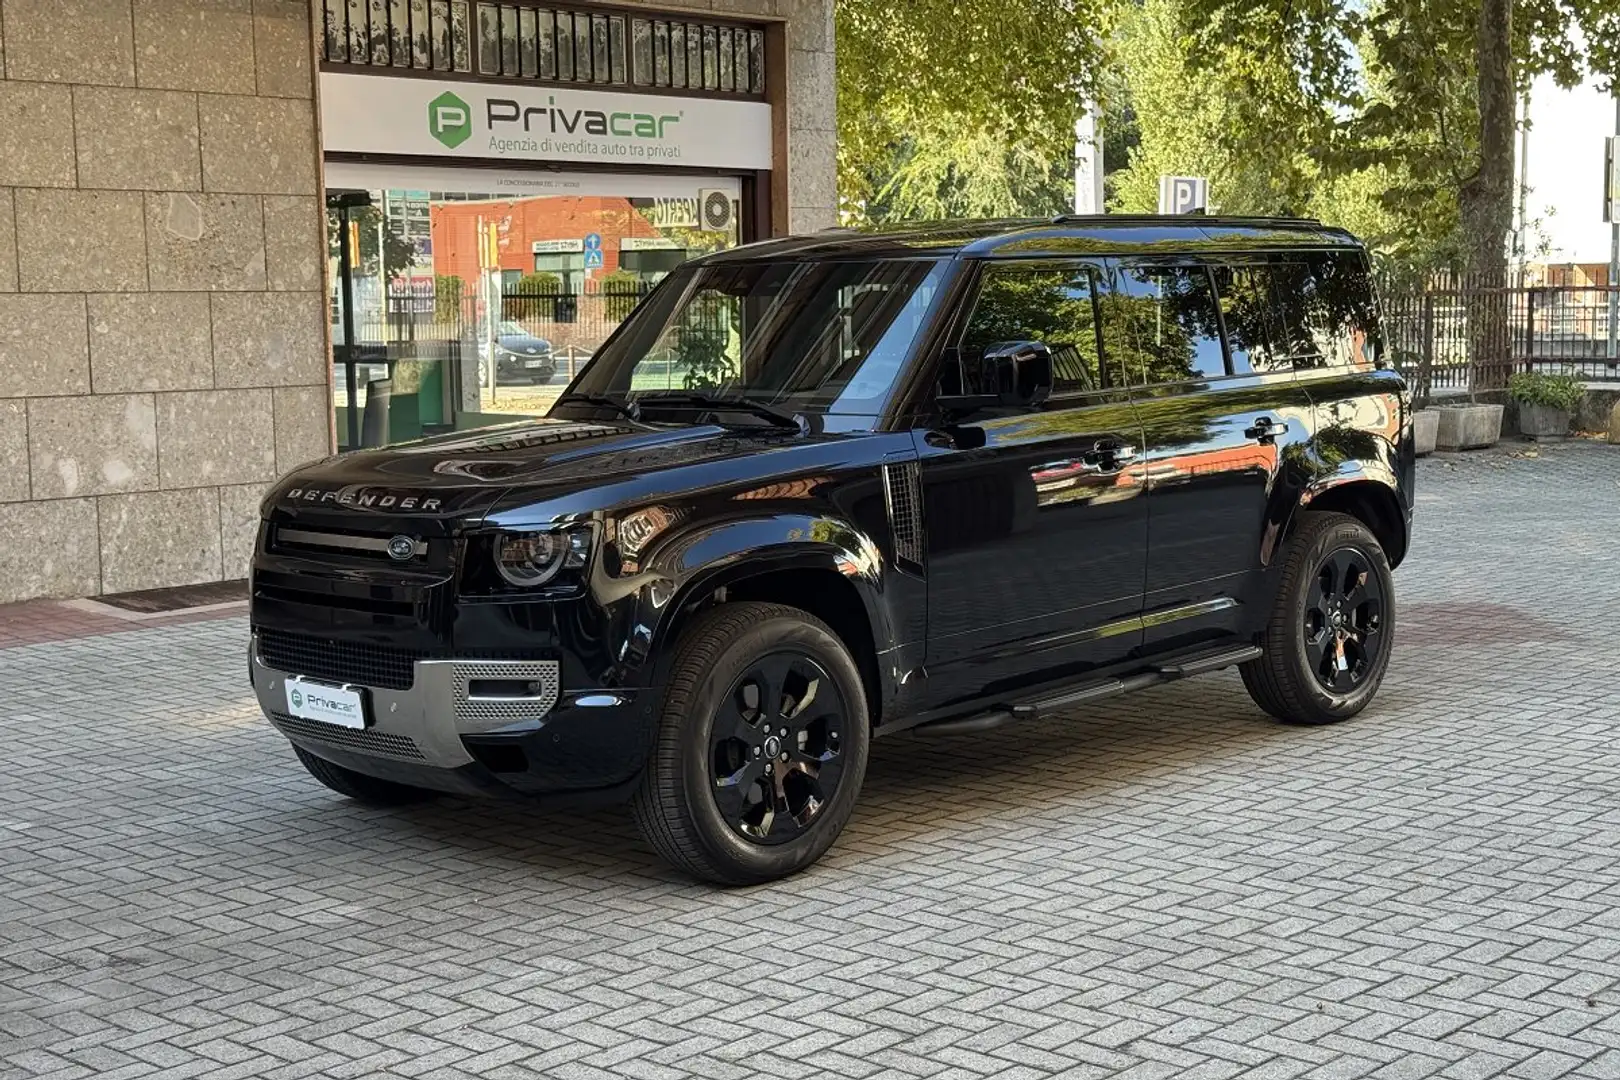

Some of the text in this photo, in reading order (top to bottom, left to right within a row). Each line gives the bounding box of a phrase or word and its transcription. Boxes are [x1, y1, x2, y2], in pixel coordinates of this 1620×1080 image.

[486, 96, 680, 139] Privacar
[488, 136, 681, 159] Agenzia di vendita auto tra privati
[1176, 182, 1192, 214] P
[287, 488, 442, 510] DEFENDER
[307, 694, 356, 713] Privacar
